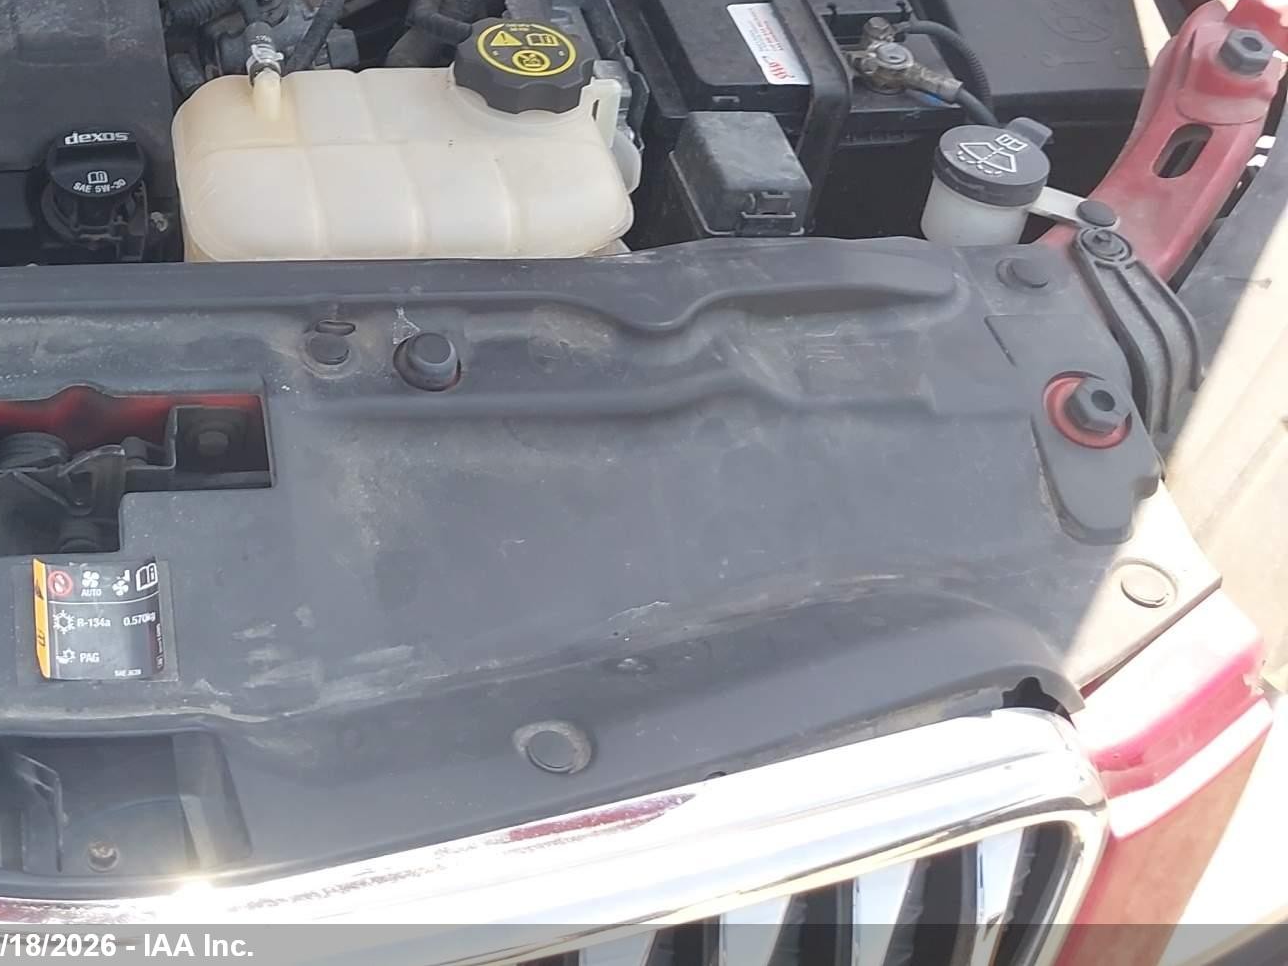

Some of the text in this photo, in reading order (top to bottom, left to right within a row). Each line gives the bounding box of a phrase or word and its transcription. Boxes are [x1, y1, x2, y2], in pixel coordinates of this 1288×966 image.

[64, 131, 130, 145] dexos
[72, 178, 126, 193] SAE 5W-30
[81, 589, 102, 597] AUTO
[77, 617, 111, 627] R-134a
[79, 652, 100, 663] PAG
